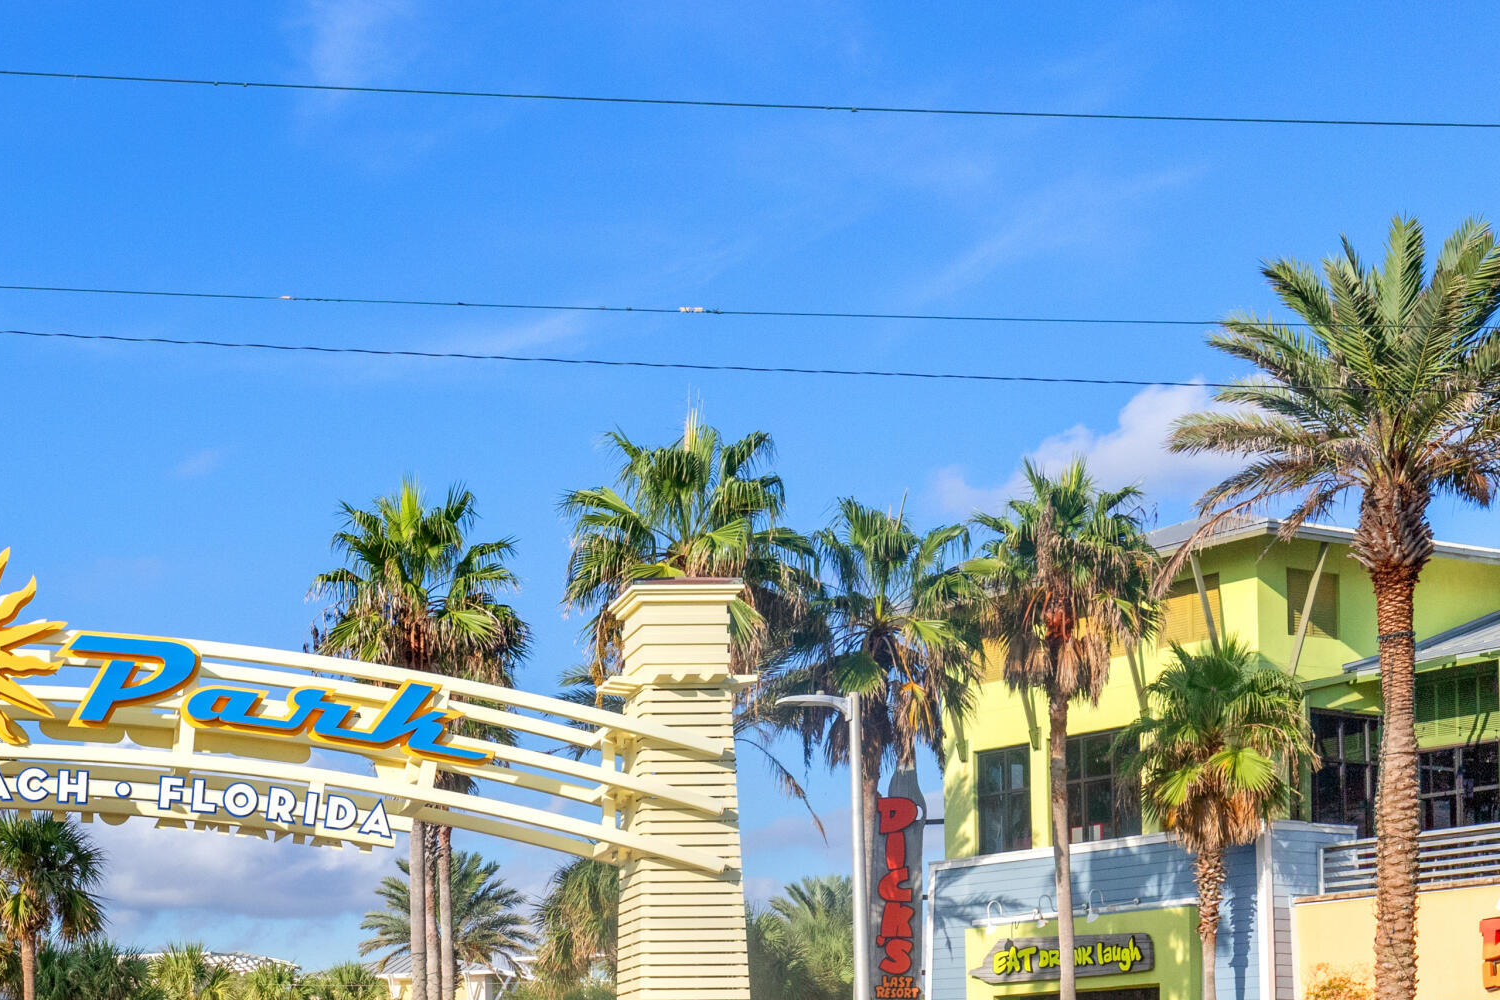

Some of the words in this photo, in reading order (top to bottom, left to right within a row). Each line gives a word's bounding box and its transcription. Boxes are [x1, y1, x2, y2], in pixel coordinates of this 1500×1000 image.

[56, 630, 495, 766] Park
[157, 775, 394, 840] FLORIDA
[877, 797, 918, 974] DICK'S
[882, 974, 914, 987] LAST
[993, 945, 1038, 975] EAT
[1038, 945, 1096, 969] DRNK
[1096, 935, 1143, 972] laugh
[876, 986, 920, 999] RESORT
